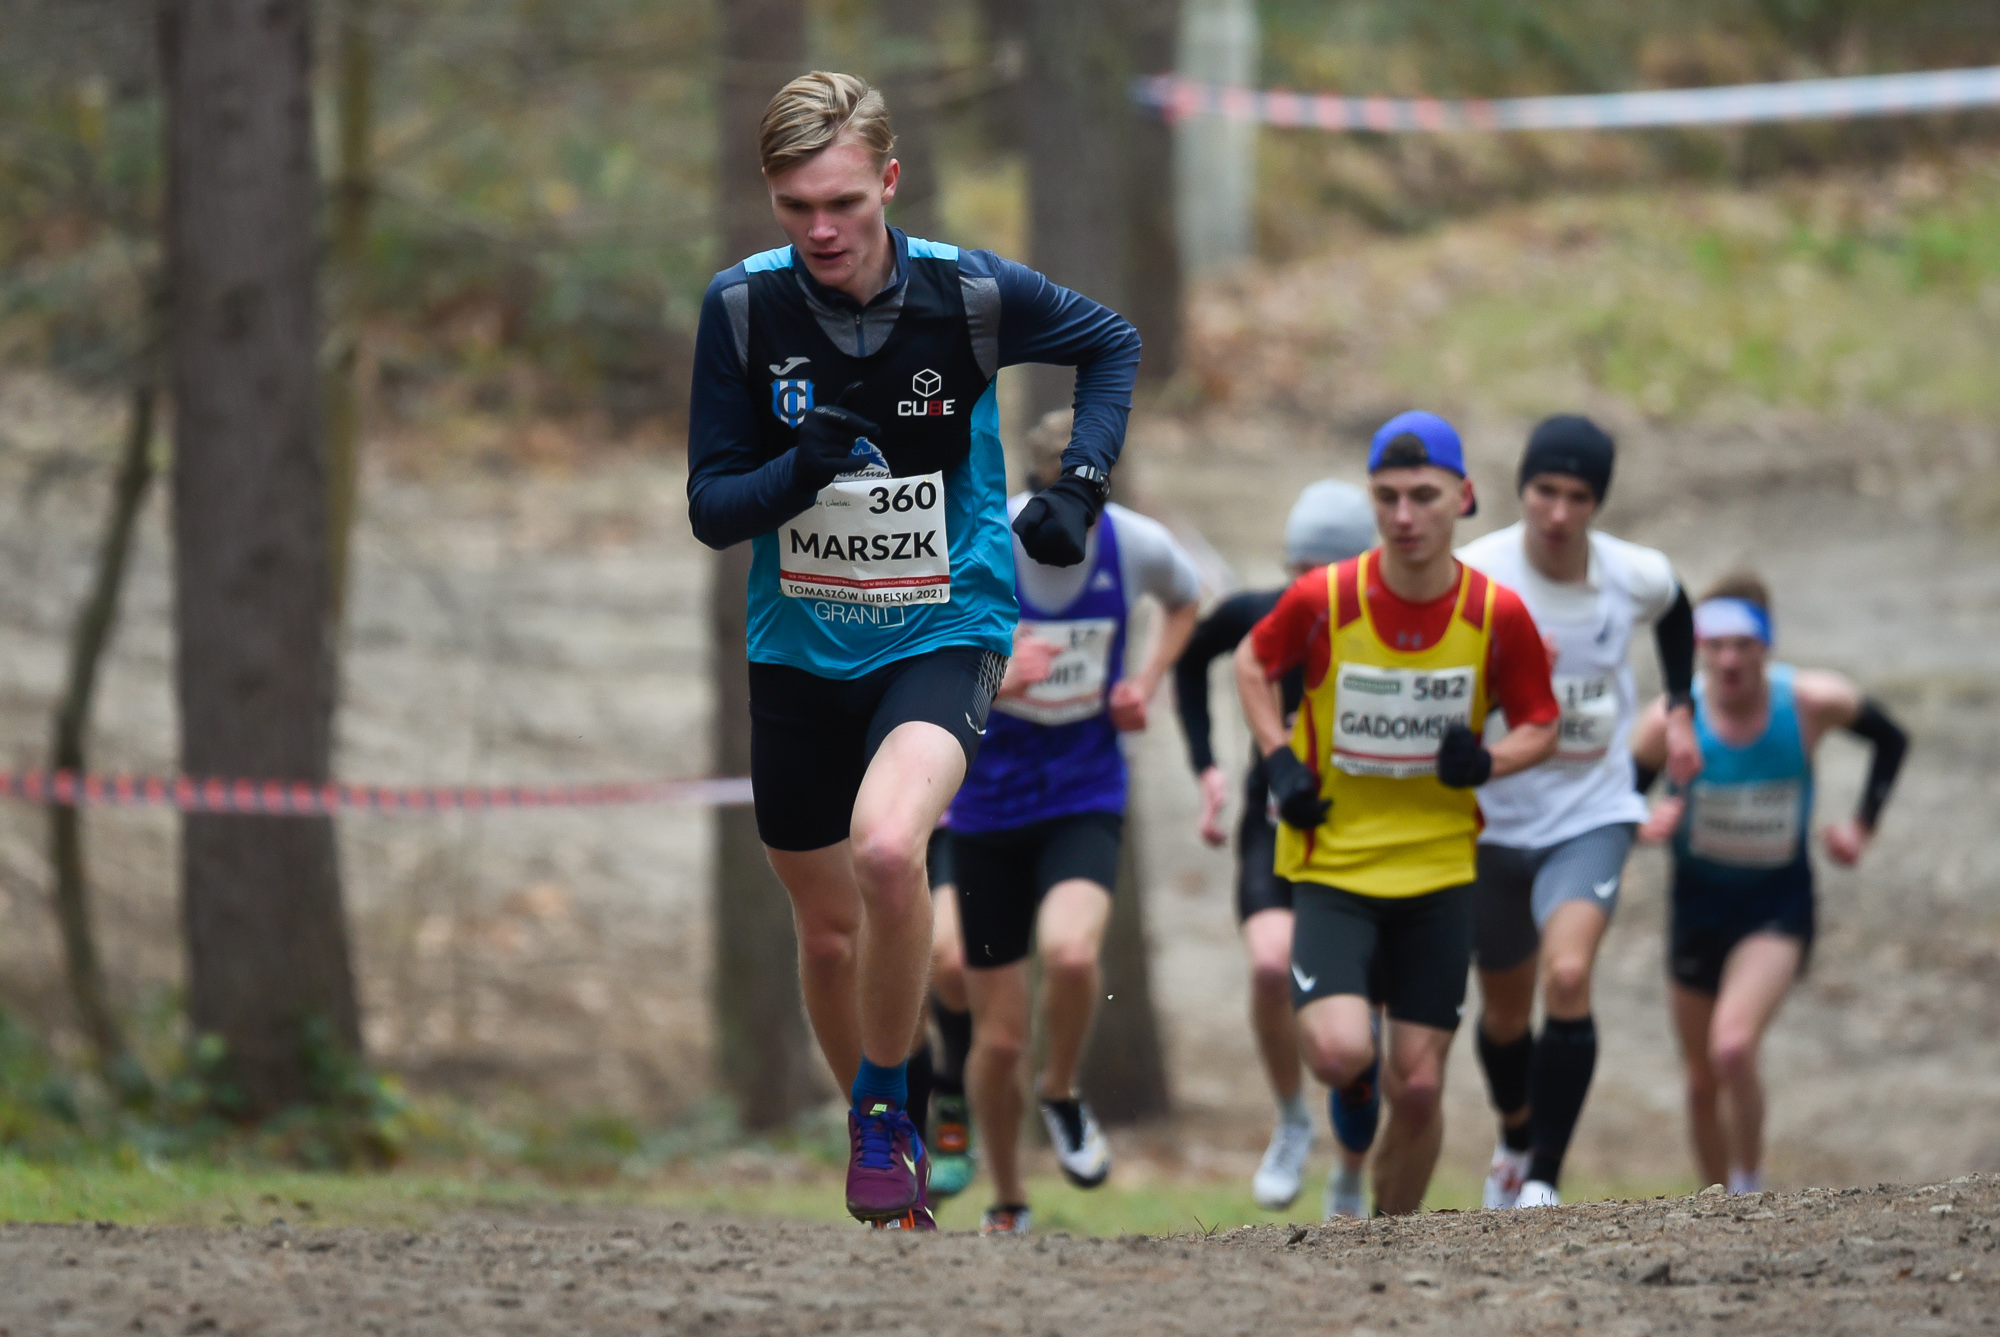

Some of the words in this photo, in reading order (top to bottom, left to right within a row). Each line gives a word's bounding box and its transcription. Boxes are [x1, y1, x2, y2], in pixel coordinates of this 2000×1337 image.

[898, 399, 956, 416] CUBE
[839, 466, 890, 480] artuzy
[868, 481, 937, 515] 360
[790, 528, 938, 562] MARSZK
[788, 584, 859, 601] TOMASZÓW
[862, 592, 913, 603] LUBELSKI
[916, 588, 943, 599] 2021
[1413, 675, 1466, 701] 582
